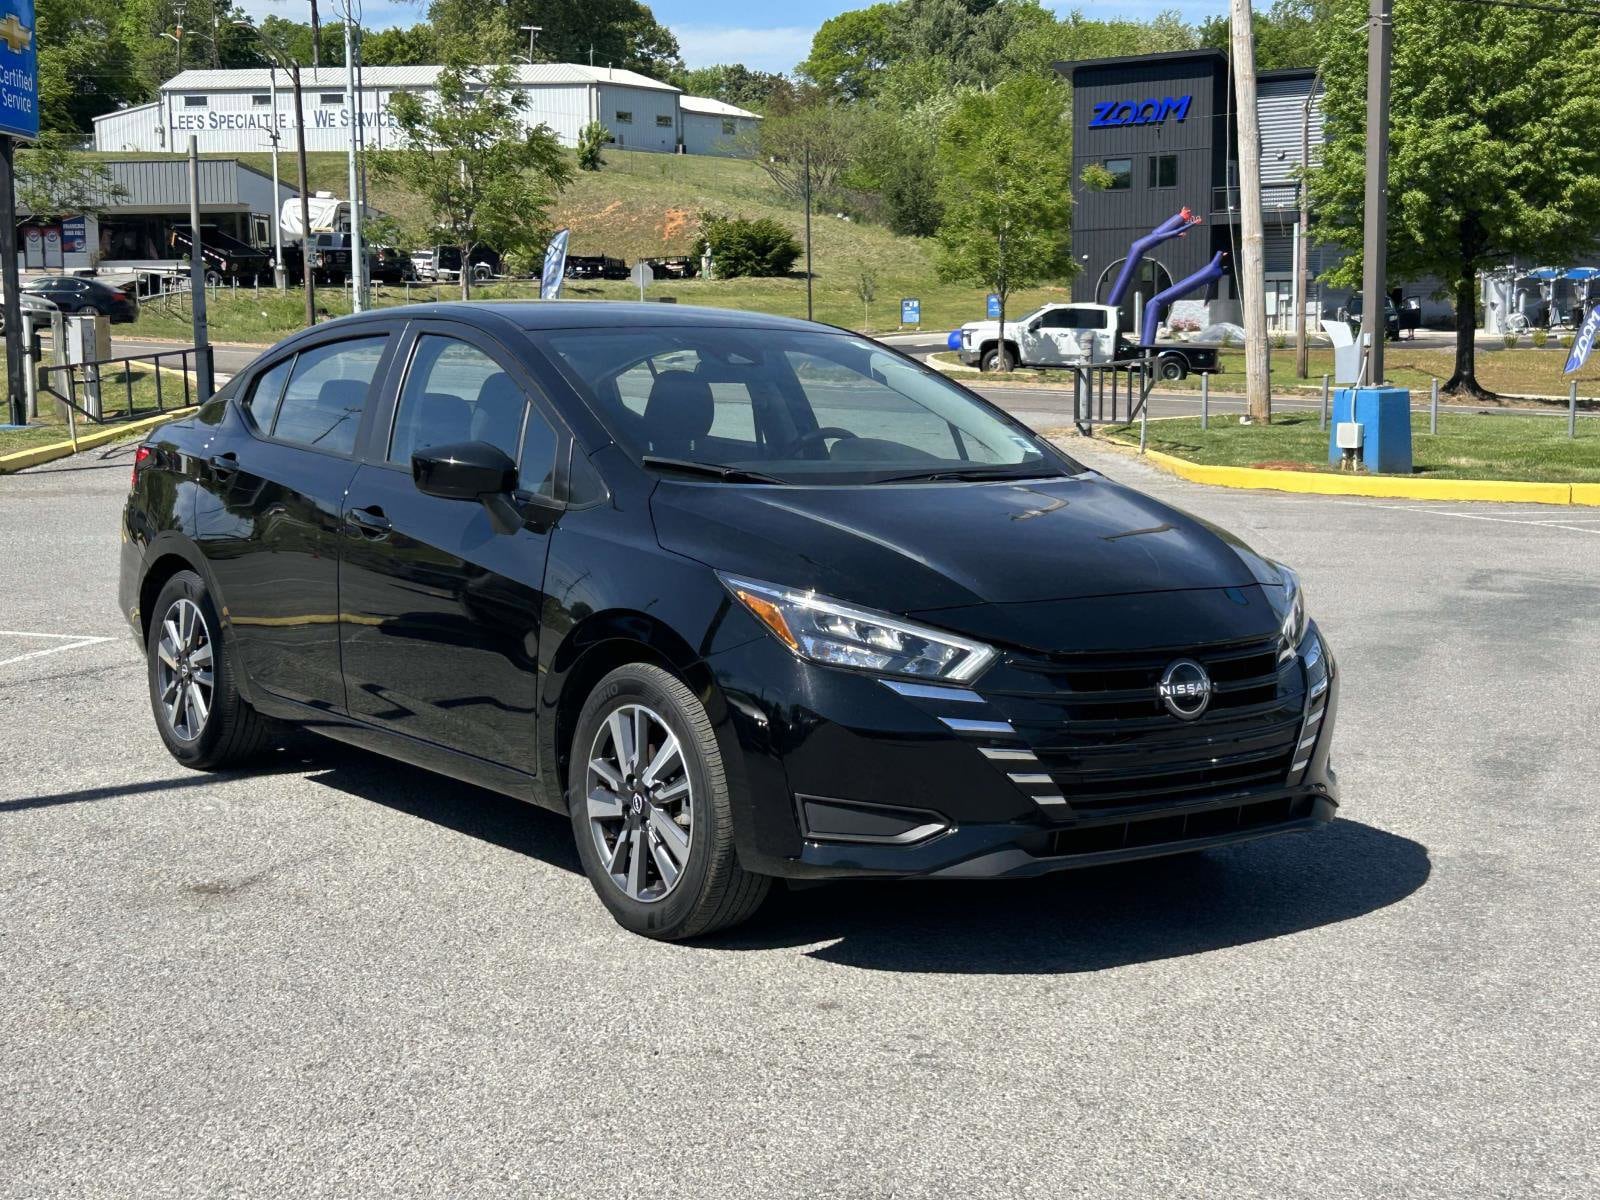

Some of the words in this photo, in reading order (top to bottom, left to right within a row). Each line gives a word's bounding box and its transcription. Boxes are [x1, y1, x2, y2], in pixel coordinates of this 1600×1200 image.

[2, 87, 32, 113] Service
[170, 111, 205, 130] LEE'S
[208, 110, 287, 130] SPECIALTE
[314, 109, 336, 128] WE
[1088, 95, 1193, 130] ZOOM
[1160, 681, 1210, 696] NISSAN
